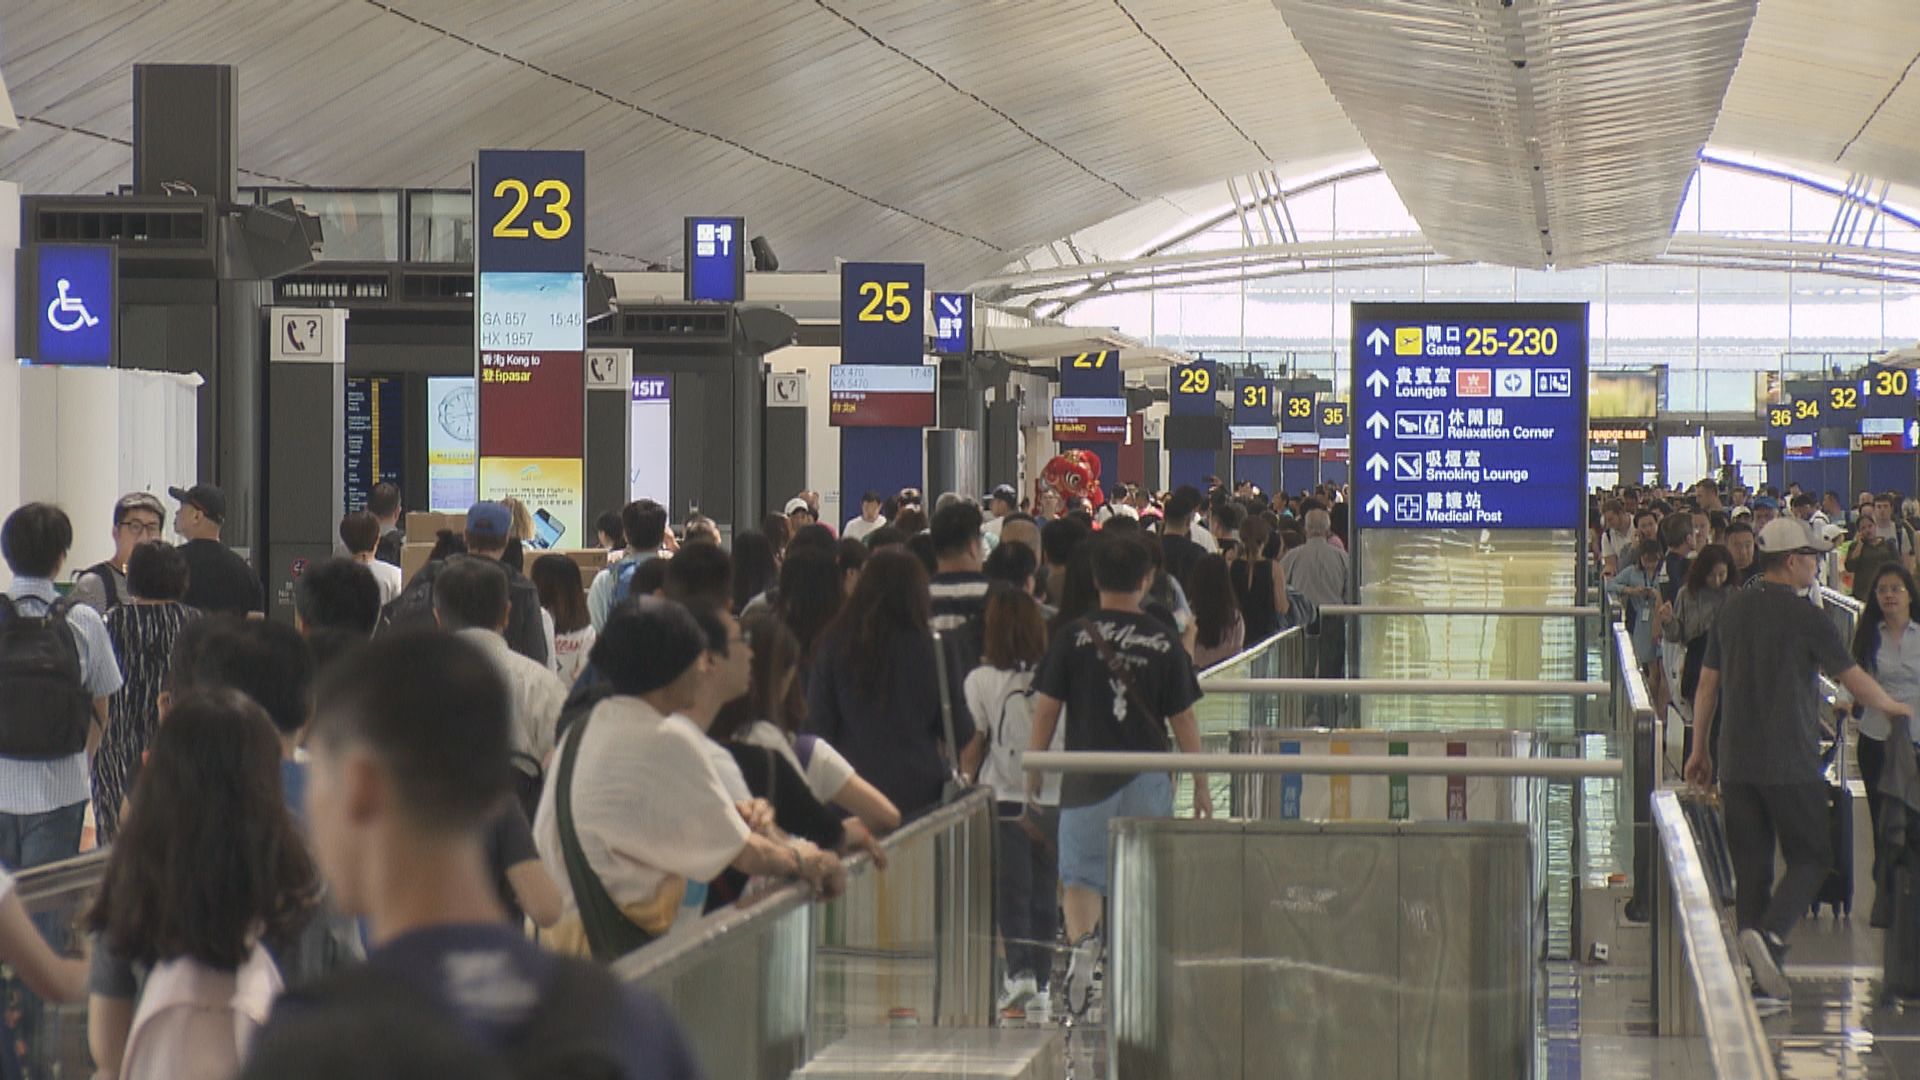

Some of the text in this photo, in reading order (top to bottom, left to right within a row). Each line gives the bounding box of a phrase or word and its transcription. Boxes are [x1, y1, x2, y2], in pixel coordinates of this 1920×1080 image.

[493, 179, 572, 239] 23
[858, 281, 911, 323] 25
[482, 312, 582, 326] GA 857 15:45
[482, 332, 534, 345] HX 1957
[1465, 327, 1558, 356] 25-230
[1426, 343, 1461, 356] Gates
[1180, 367, 1210, 393] 29
[1876, 370, 1908, 396] 30
[1243, 385, 1266, 407] 31
[1396, 384, 1447, 399] Lounges
[1831, 387, 1857, 409] 32
[1288, 397, 1311, 417] 33
[1796, 400, 1819, 419] 34
[1323, 408, 1343, 425] 35
[1771, 409, 1792, 427] 36
[1448, 426, 1554, 439] Relaxation Corner
[1426, 468, 1528, 483] Smoking Lounge
[1426, 509, 1503, 522] Medical Post
